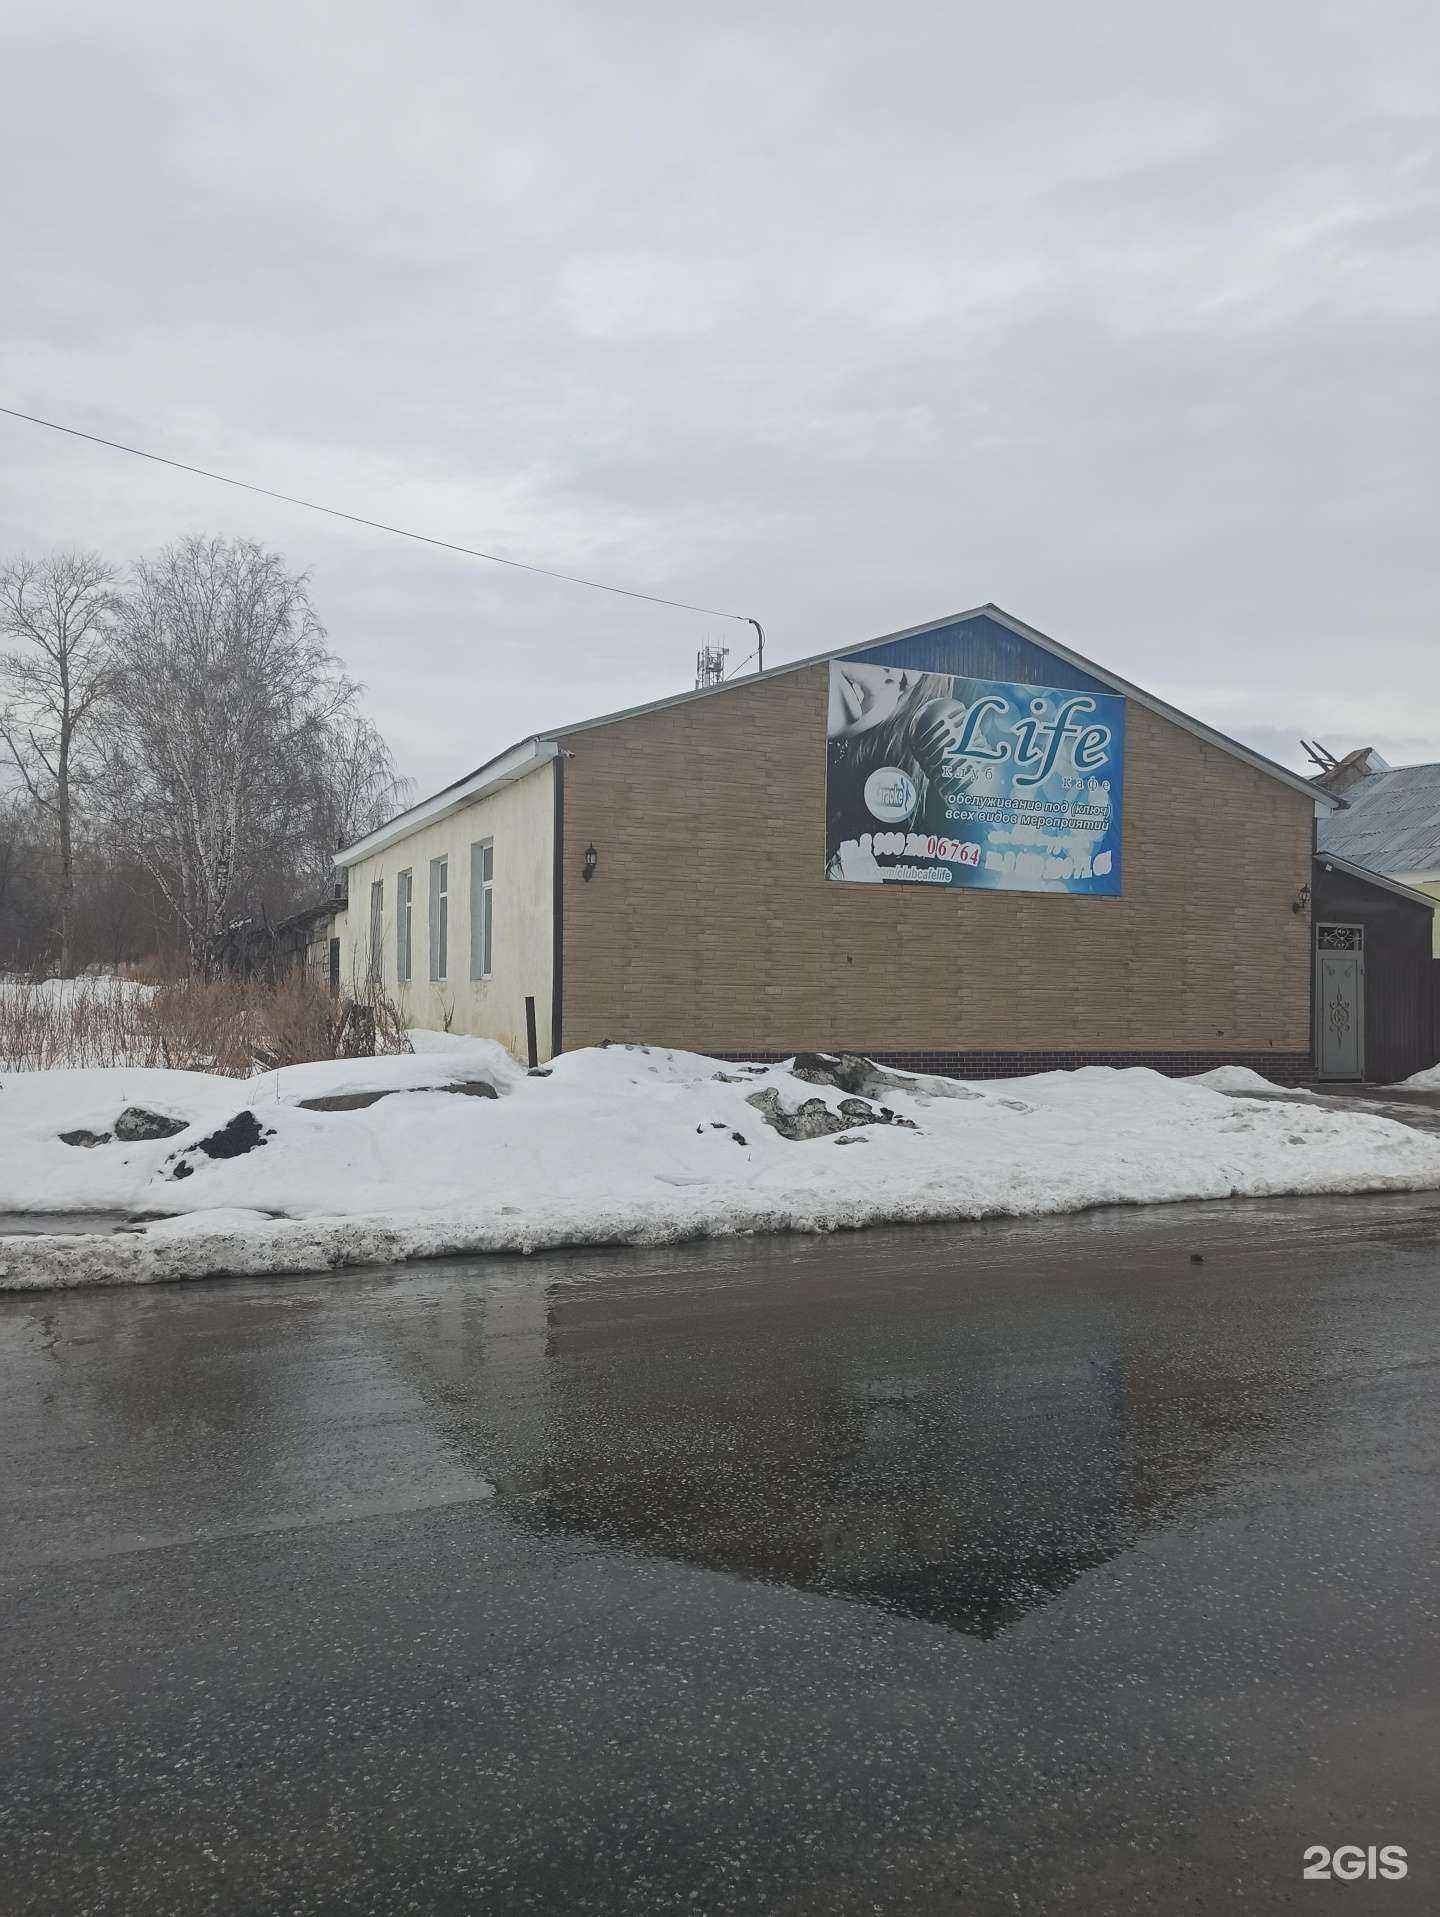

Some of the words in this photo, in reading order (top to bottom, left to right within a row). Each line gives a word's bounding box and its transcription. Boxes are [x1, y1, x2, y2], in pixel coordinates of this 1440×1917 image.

[942, 695, 1112, 787] Life
[942, 765, 993, 781] клуб
[1062, 776, 1111, 792] кафе
[948, 793, 1042, 812] обслуживание
[1045, 802, 1069, 813] под
[1071, 803, 1111, 819] (ключ)
[945, 809, 975, 821] всех
[979, 812, 1018, 825] видов
[1020, 814, 1110, 831] мероприятий
